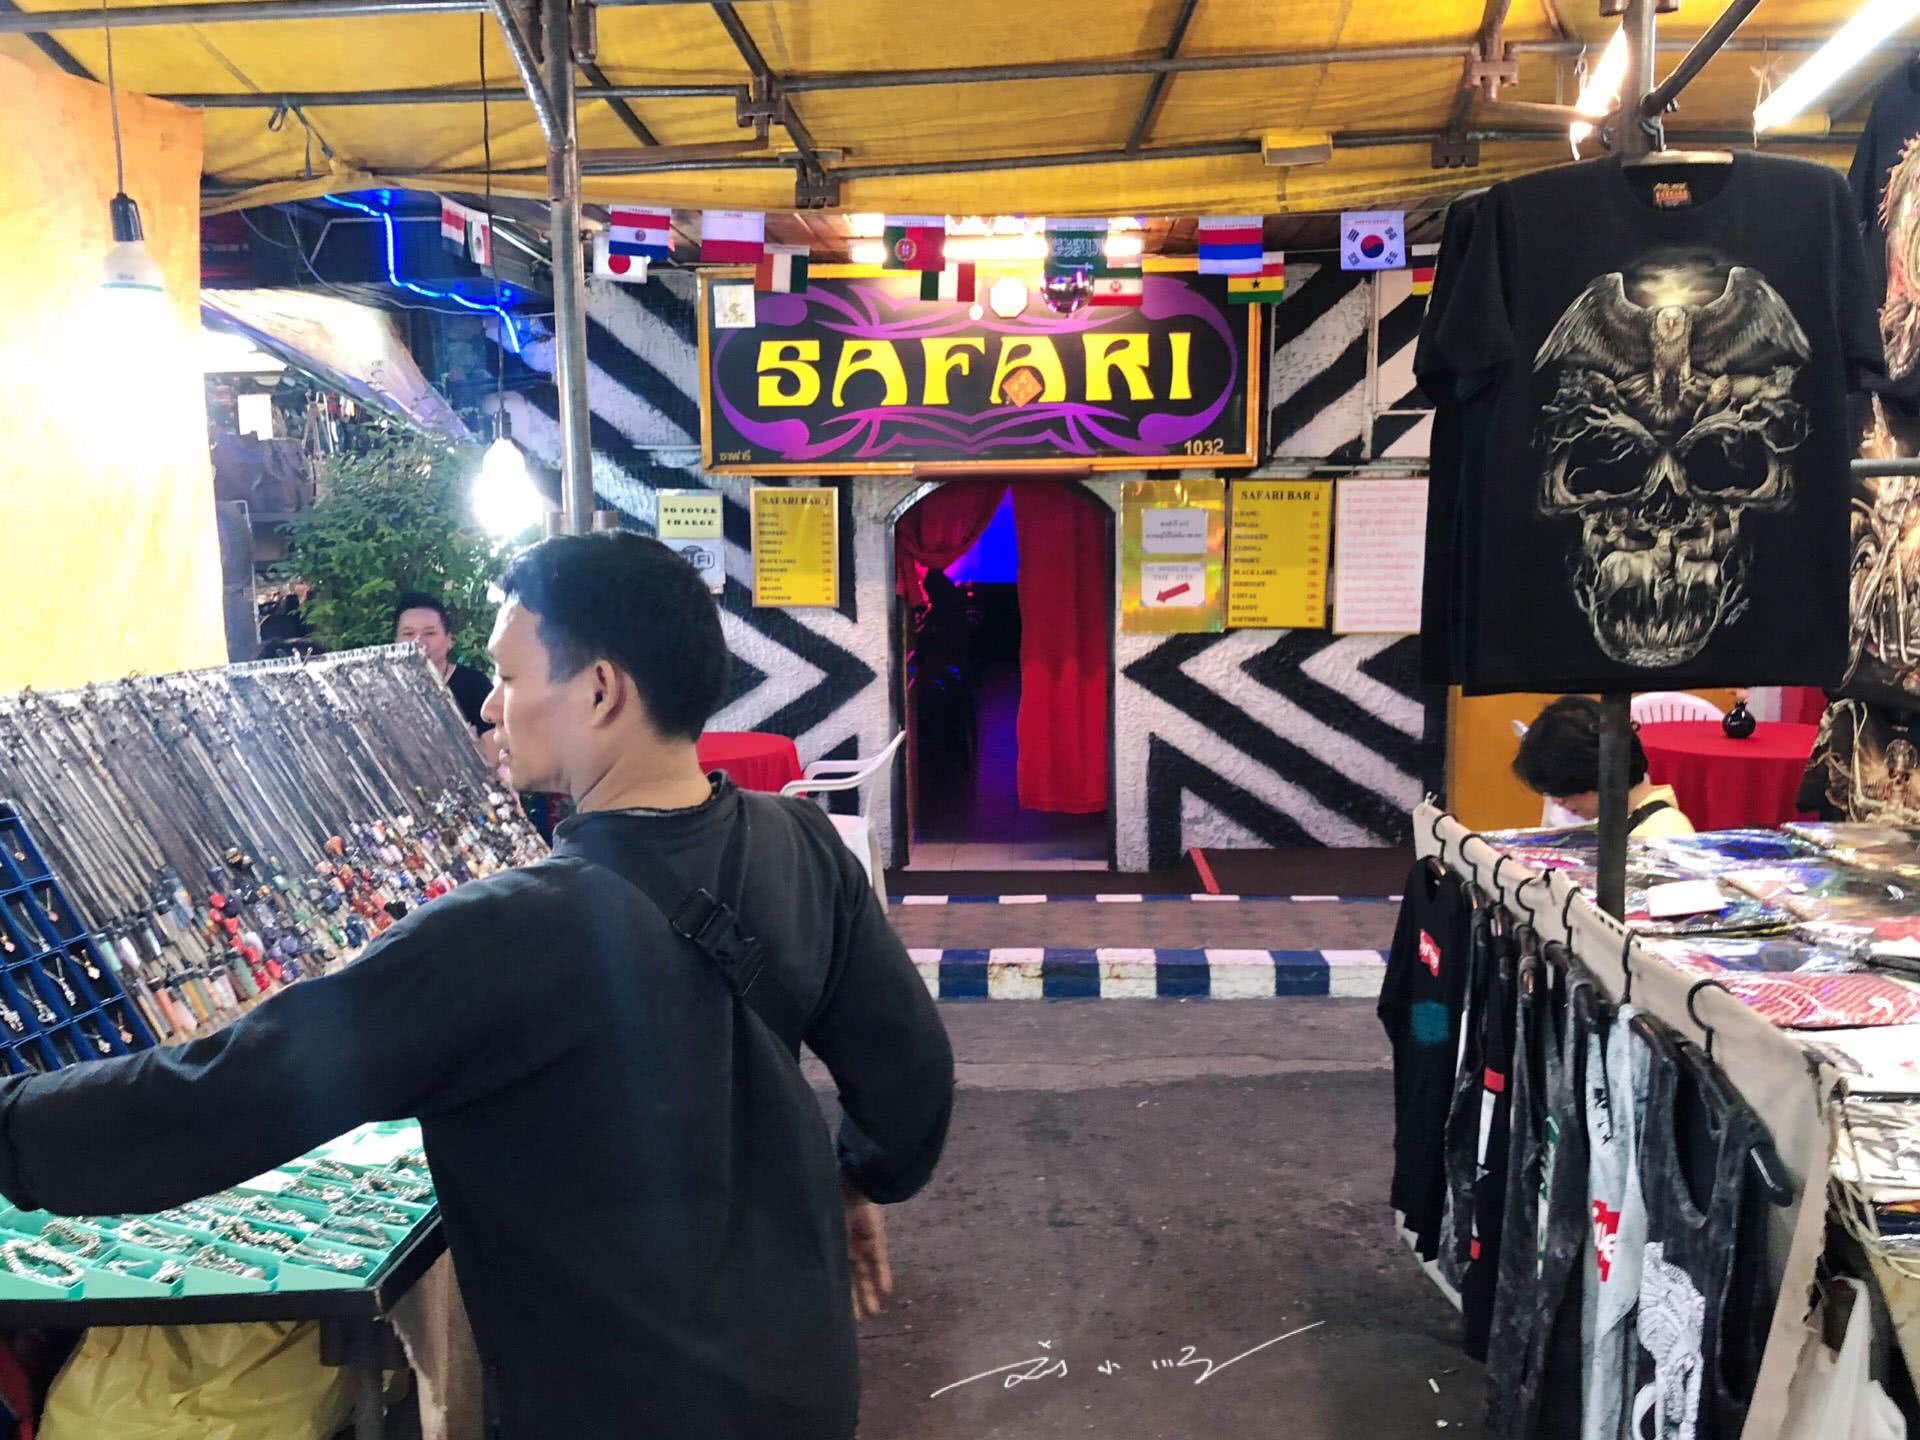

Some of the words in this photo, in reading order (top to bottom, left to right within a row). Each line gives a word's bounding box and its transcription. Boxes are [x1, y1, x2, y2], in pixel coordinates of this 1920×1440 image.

[757, 332, 1192, 408] SAFARI
[1183, 438, 1225, 456] 1032
[1241, 490, 1284, 501] SAFARI
[1287, 490, 1312, 501] BAR
[681, 507, 718, 515] COVER
[666, 519, 714, 527] CHARGE
